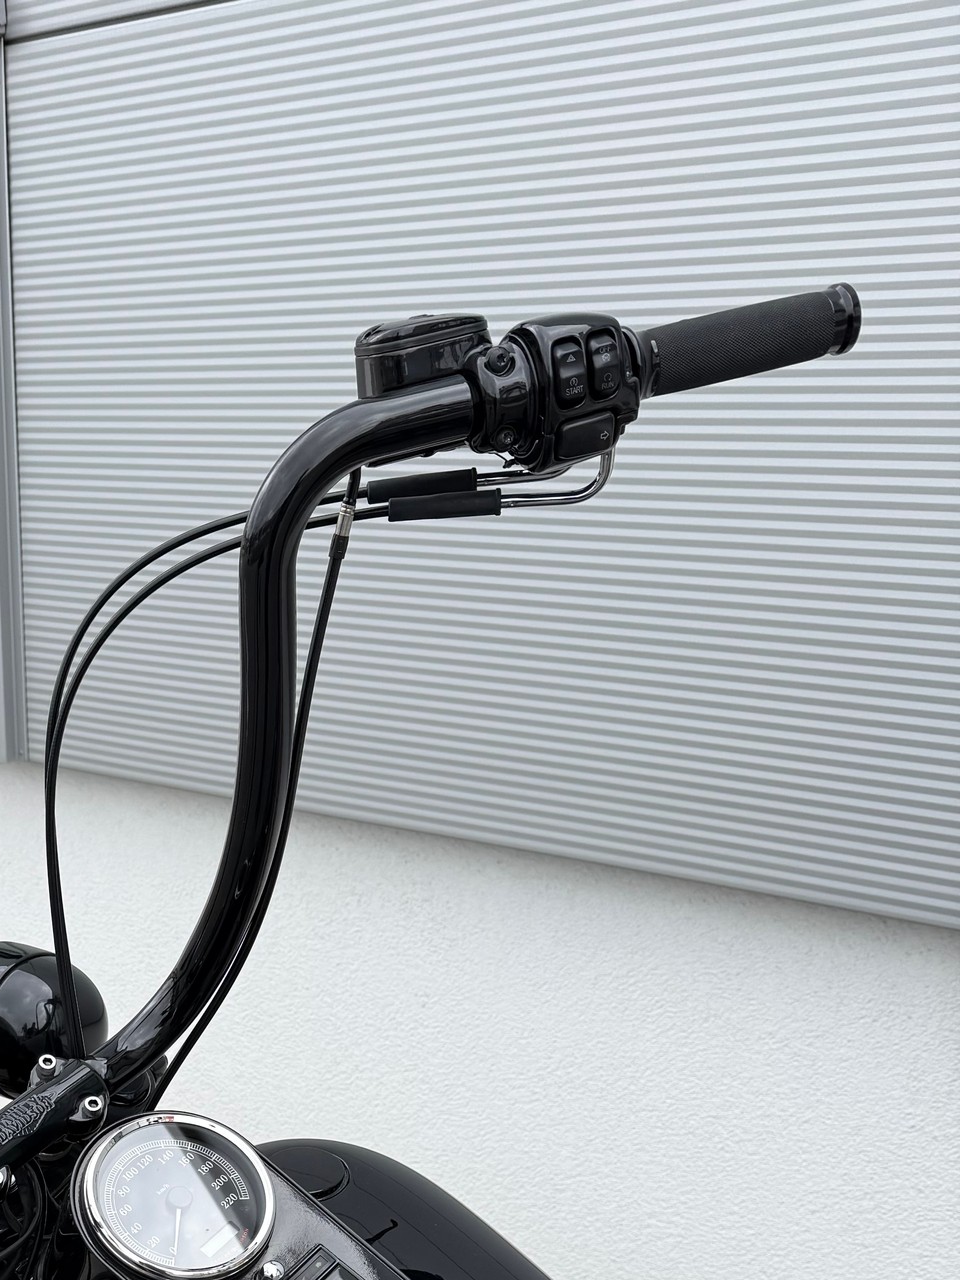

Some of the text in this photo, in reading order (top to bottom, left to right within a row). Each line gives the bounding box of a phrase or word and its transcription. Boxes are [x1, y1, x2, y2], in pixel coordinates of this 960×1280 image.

[566, 385, 583, 395] START
[137, 1154, 153, 1169] 120
[158, 1150, 174, 1165] 140
[178, 1152, 194, 1166] 160
[122, 1167, 139, 1182] 100
[198, 1161, 214, 1175] 180
[211, 1174, 229, 1190] 200
[118, 1185, 130, 1197] 80
[221, 1193, 238, 1209] 220
[119, 1203, 132, 1216] 60
[130, 1222, 142, 1234] 40
[147, 1236, 160, 1248] 20
